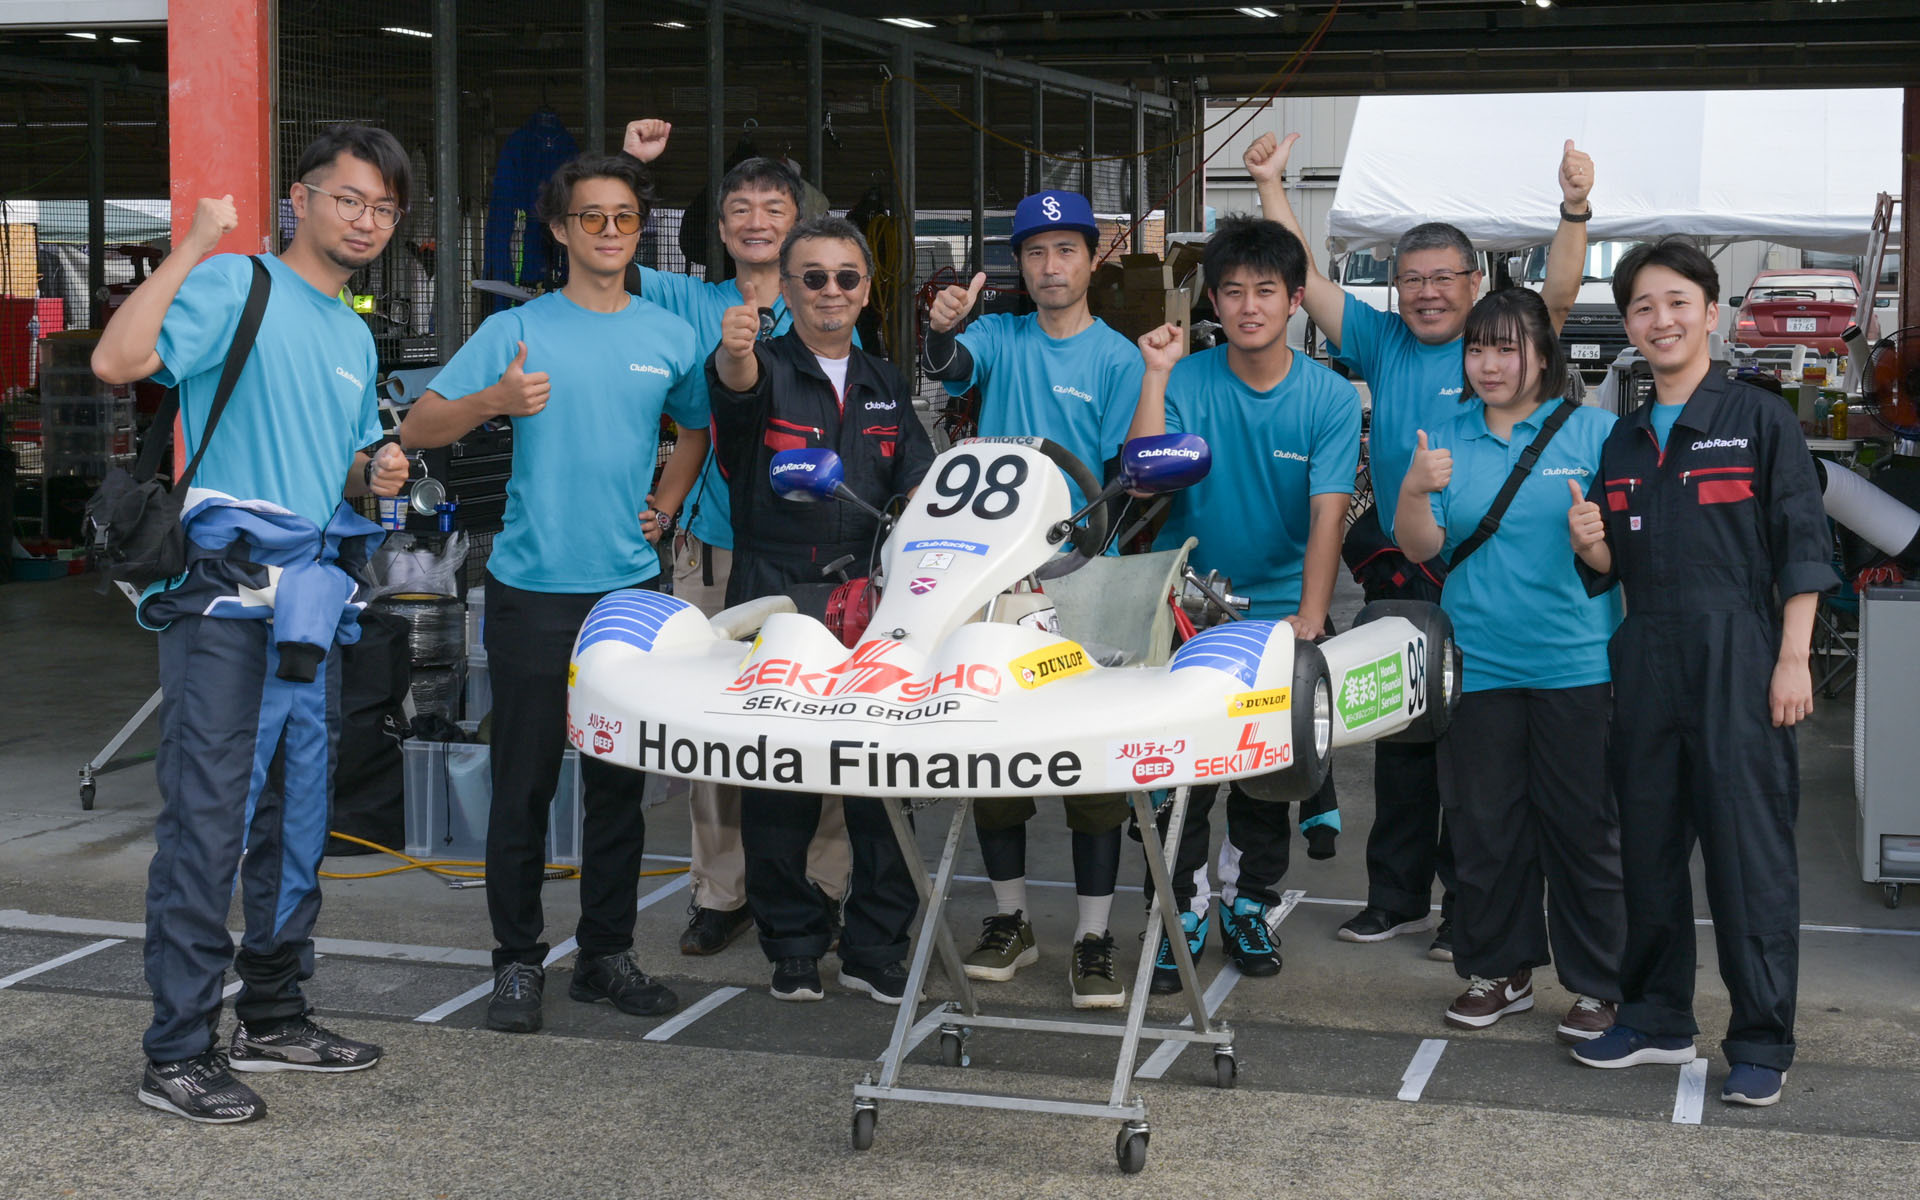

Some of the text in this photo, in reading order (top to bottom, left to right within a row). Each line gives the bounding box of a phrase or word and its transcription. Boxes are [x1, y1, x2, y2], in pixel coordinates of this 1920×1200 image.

[926, 454, 1029, 521] 98
[1037, 650, 1083, 678] DUNLOP
[1408, 637, 1424, 716] 98
[742, 695, 961, 721] SEKISHO GROUP
[1246, 694, 1286, 708] DUNLOP
[594, 735, 613, 750] BEEF
[638, 720, 1083, 790] Honda Finance
[1115, 739, 1186, 760] メルティーク
[1135, 762, 1172, 777] BEEF
